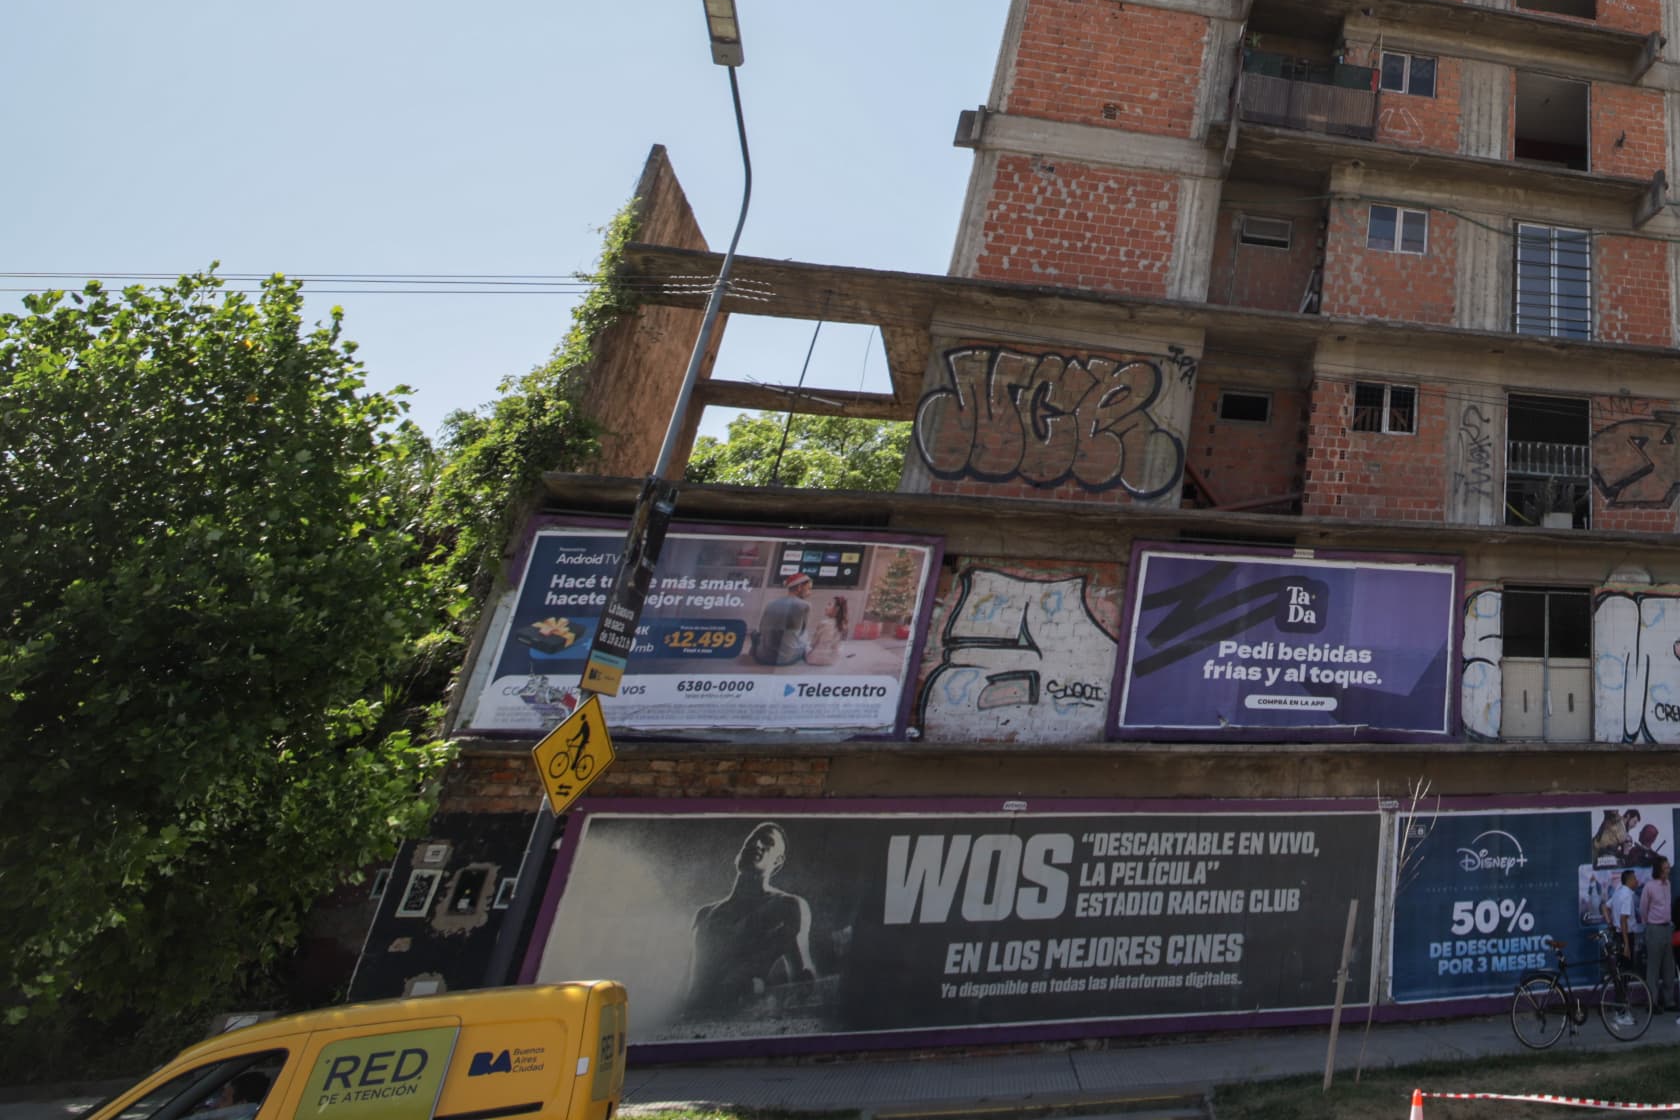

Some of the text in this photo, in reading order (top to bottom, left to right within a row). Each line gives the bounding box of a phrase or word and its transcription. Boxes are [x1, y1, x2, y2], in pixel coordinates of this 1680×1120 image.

[556, 552, 622, 566] Android TV
[550, 574, 596, 589] Hacé
[661, 575, 697, 590] más
[699, 577, 753, 593] smart,
[1286, 585, 1310, 605] Ta
[545, 592, 606, 606] hacete
[686, 593, 745, 610] regalo.
[1287, 605, 1317, 625] Da
[663, 631, 737, 649] $12.499
[1218, 640, 1372, 664] Pedí bebidas
[1203, 660, 1382, 689] frías y al toque.
[622, 680, 887, 700] VOS 6380-0000 Telecentro
[1238, 833, 1267, 855] EN
[1268, 831, 1320, 858] VIVO,
[883, 832, 1075, 925] WOS
[1080, 862, 1107, 887] LA
[1075, 888, 1301, 918] ESTADIO RACING CLUB
[1451, 897, 1536, 936] 50%
[944, 932, 1244, 975] EN LOS MEJORES CINES
[1430, 935, 1553, 960] DE DESCUENTO
[1438, 954, 1546, 977] POR 3 MESES
[941, 983, 957, 1000] Ya
[959, 979, 1029, 1000] disponible
[1030, 981, 1048, 993] en
[1050, 977, 1087, 993] todas
[1089, 976, 1107, 991] las
[1185, 971, 1244, 990] digitales.
[513, 1047, 545, 1056] Buenos
[514, 1056, 537, 1064] Aires
[323, 1048, 429, 1092] RED
[512, 1064, 545, 1073] Ciudad
[318, 1083, 418, 1107] DE ATENCIÓN
